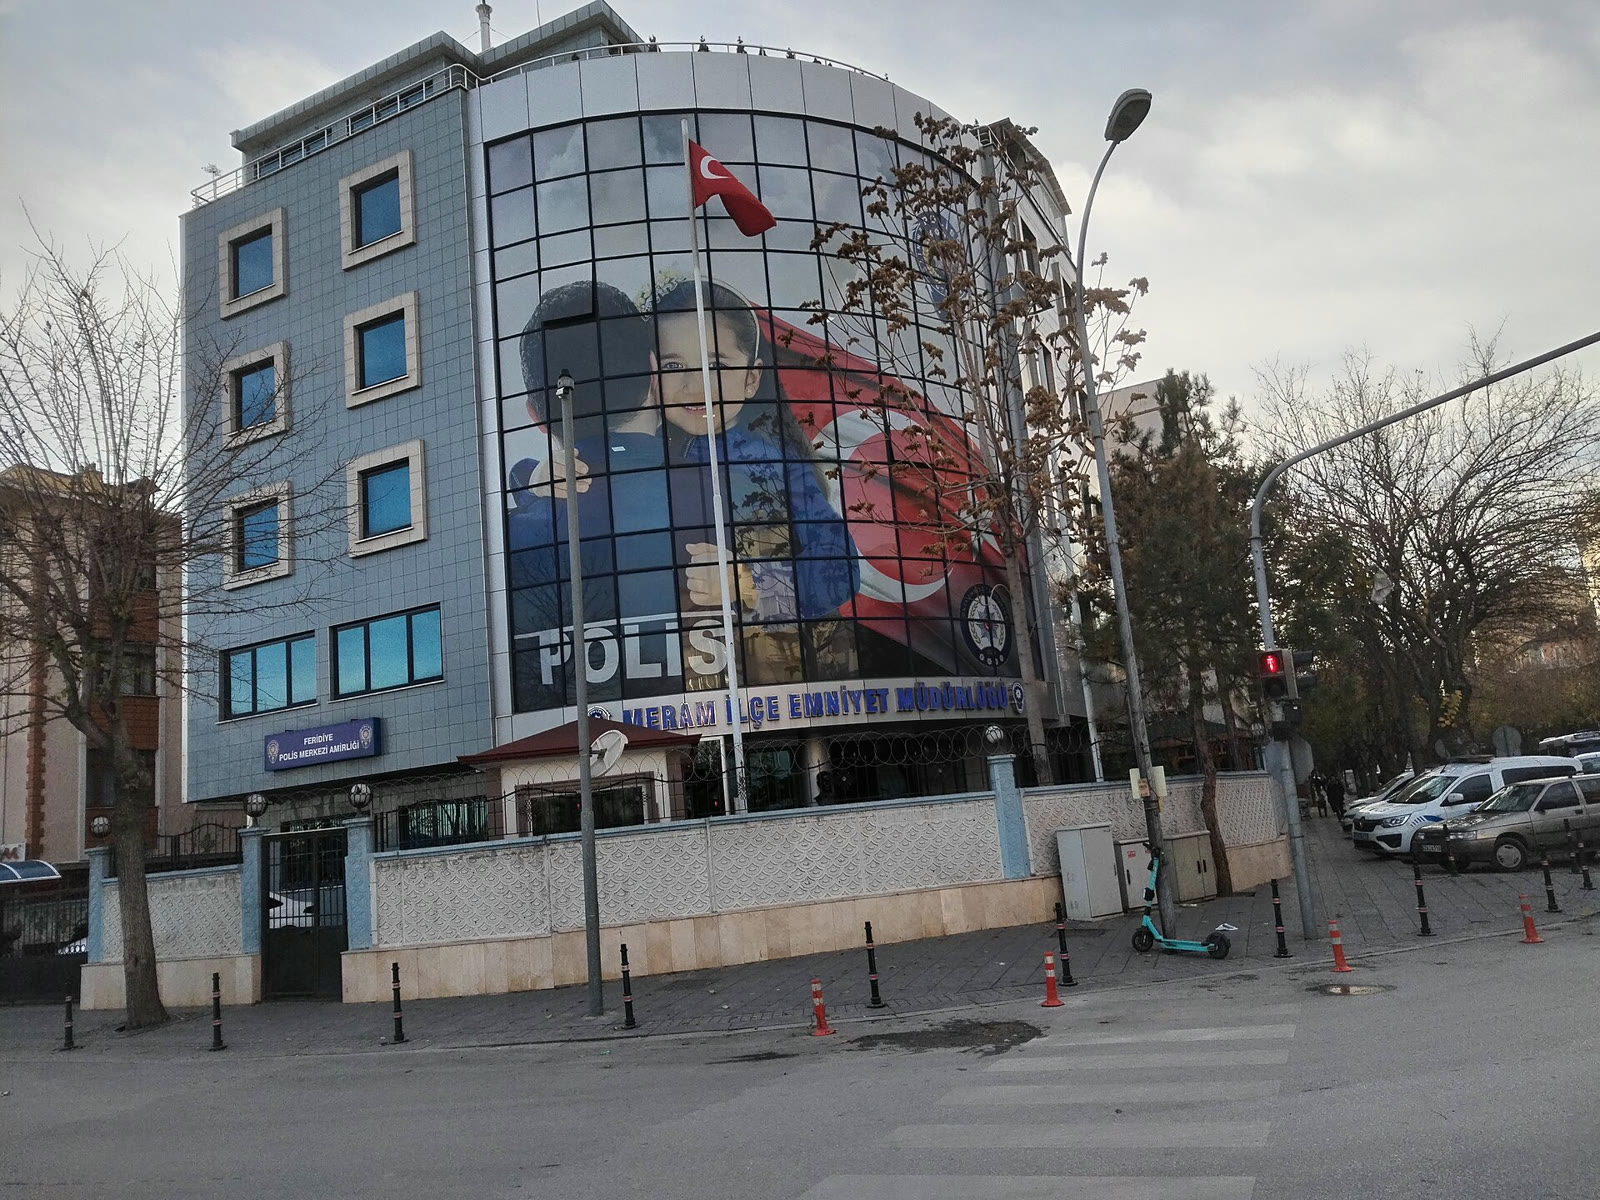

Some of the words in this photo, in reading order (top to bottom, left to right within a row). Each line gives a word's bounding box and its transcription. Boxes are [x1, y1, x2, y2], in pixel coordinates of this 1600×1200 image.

[623, 700, 717, 731] MERAM
[725, 692, 780, 728] İLÇE
[788, 685, 890, 719] EMNİYET
[896, 681, 1008, 713] MÜDÜRLÜĞÜ
[279, 749, 299, 762] POLİS
[299, 744, 328, 759] MERKEZİ
